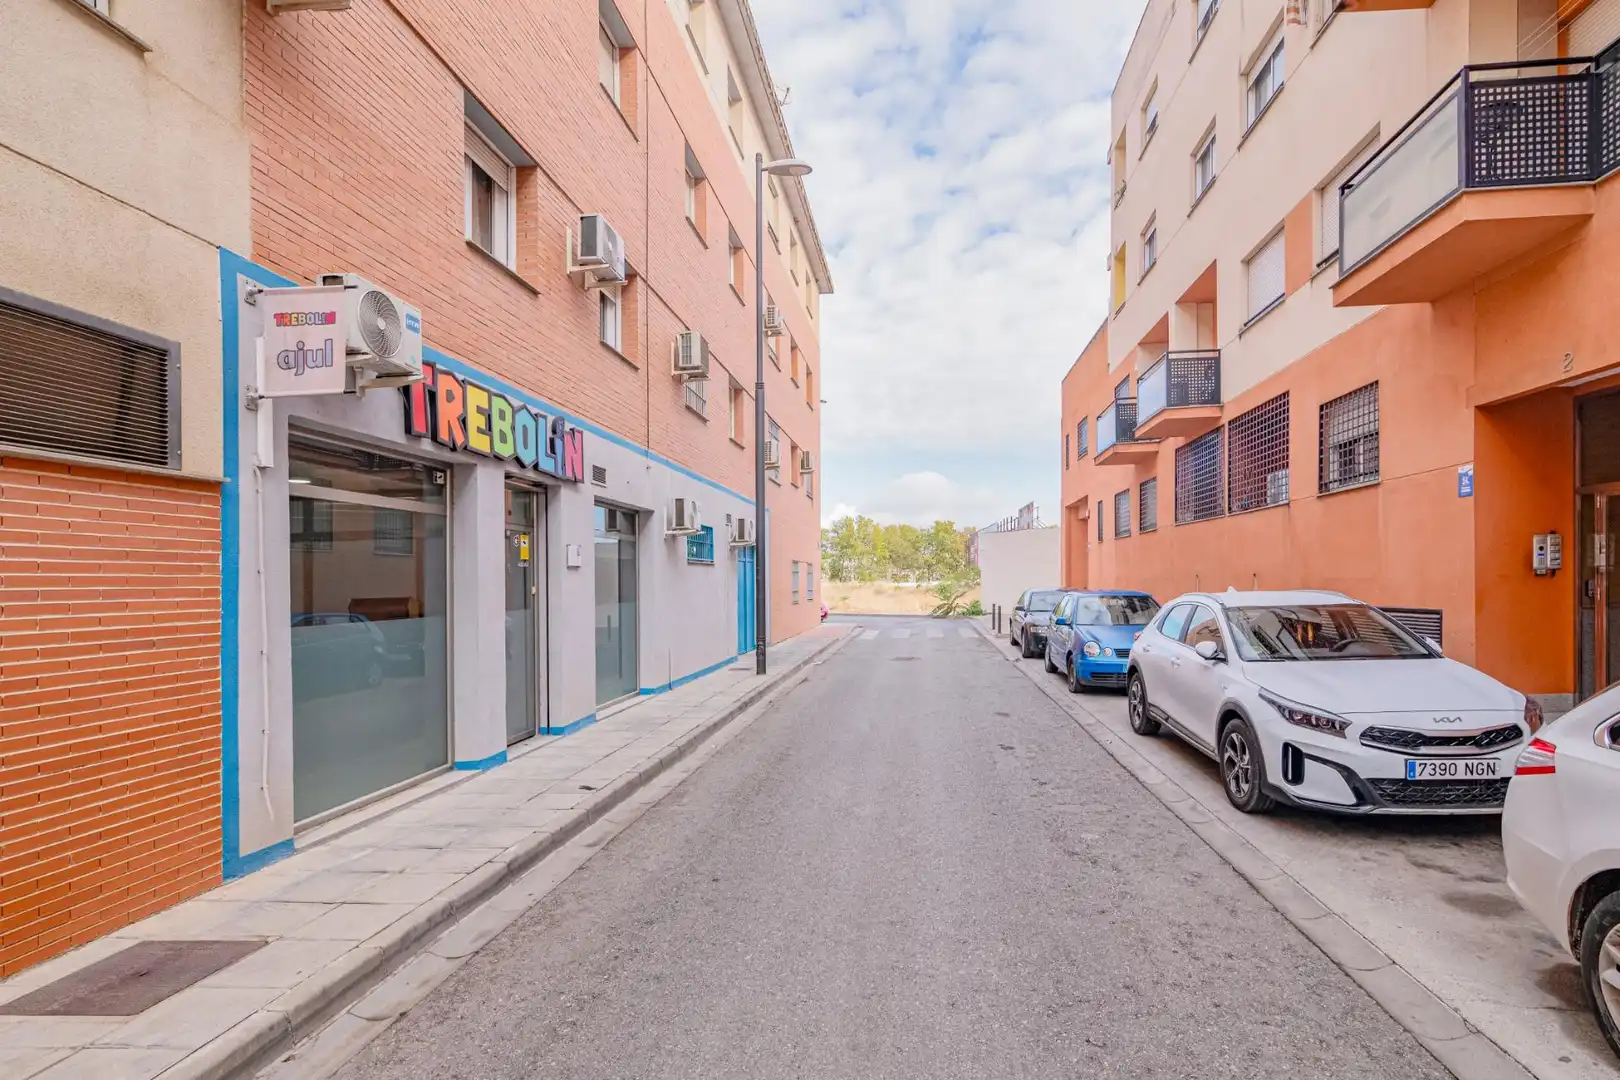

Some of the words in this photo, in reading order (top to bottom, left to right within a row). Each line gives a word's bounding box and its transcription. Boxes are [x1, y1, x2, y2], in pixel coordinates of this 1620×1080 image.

[277, 338, 333, 376] ajul
[1563, 351, 1574, 373] 2
[1418, 762, 1458, 777] 7390
[1464, 762, 1496, 777] NGN
